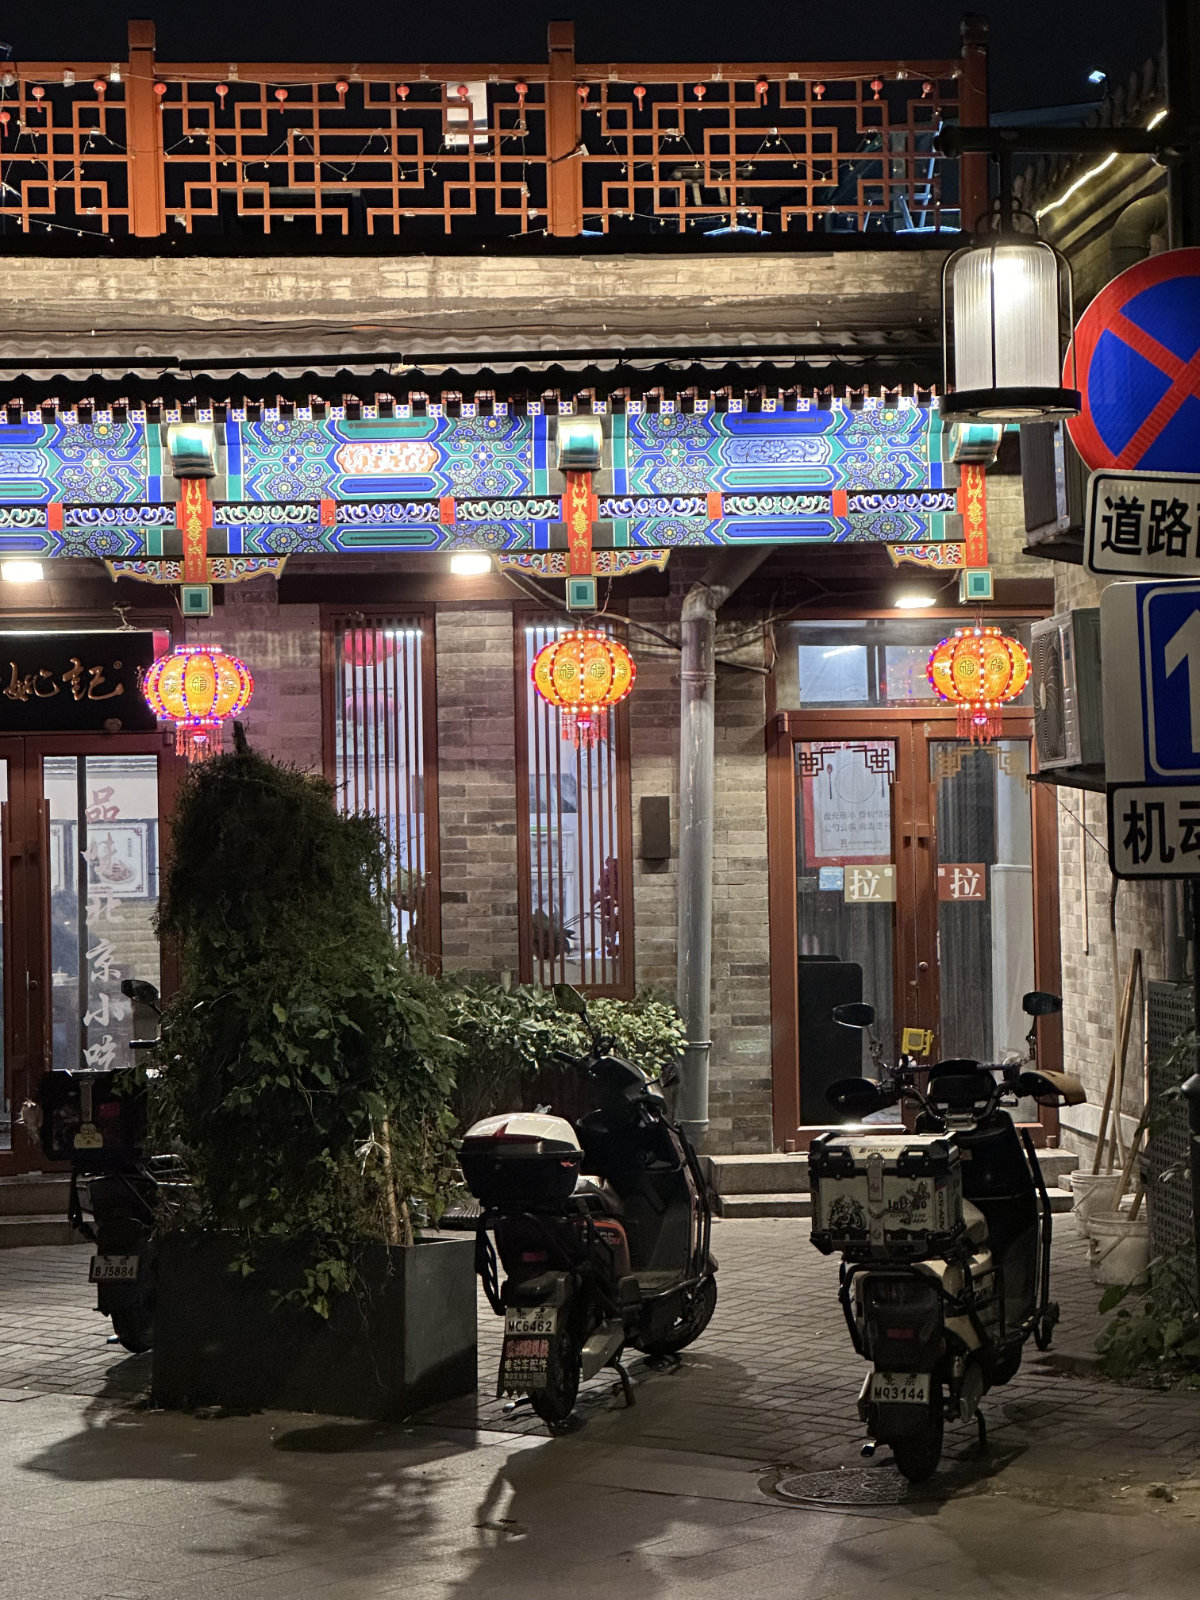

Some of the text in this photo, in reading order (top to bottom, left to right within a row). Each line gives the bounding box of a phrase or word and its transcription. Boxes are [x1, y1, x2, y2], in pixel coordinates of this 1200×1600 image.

[1100, 494, 1200, 558] 道路
[849, 869, 882, 900] 拉
[949, 867, 982, 899] 拉
[508, 1320, 552, 1332] MC6462
[874, 1386, 925, 1400] MQ3144
